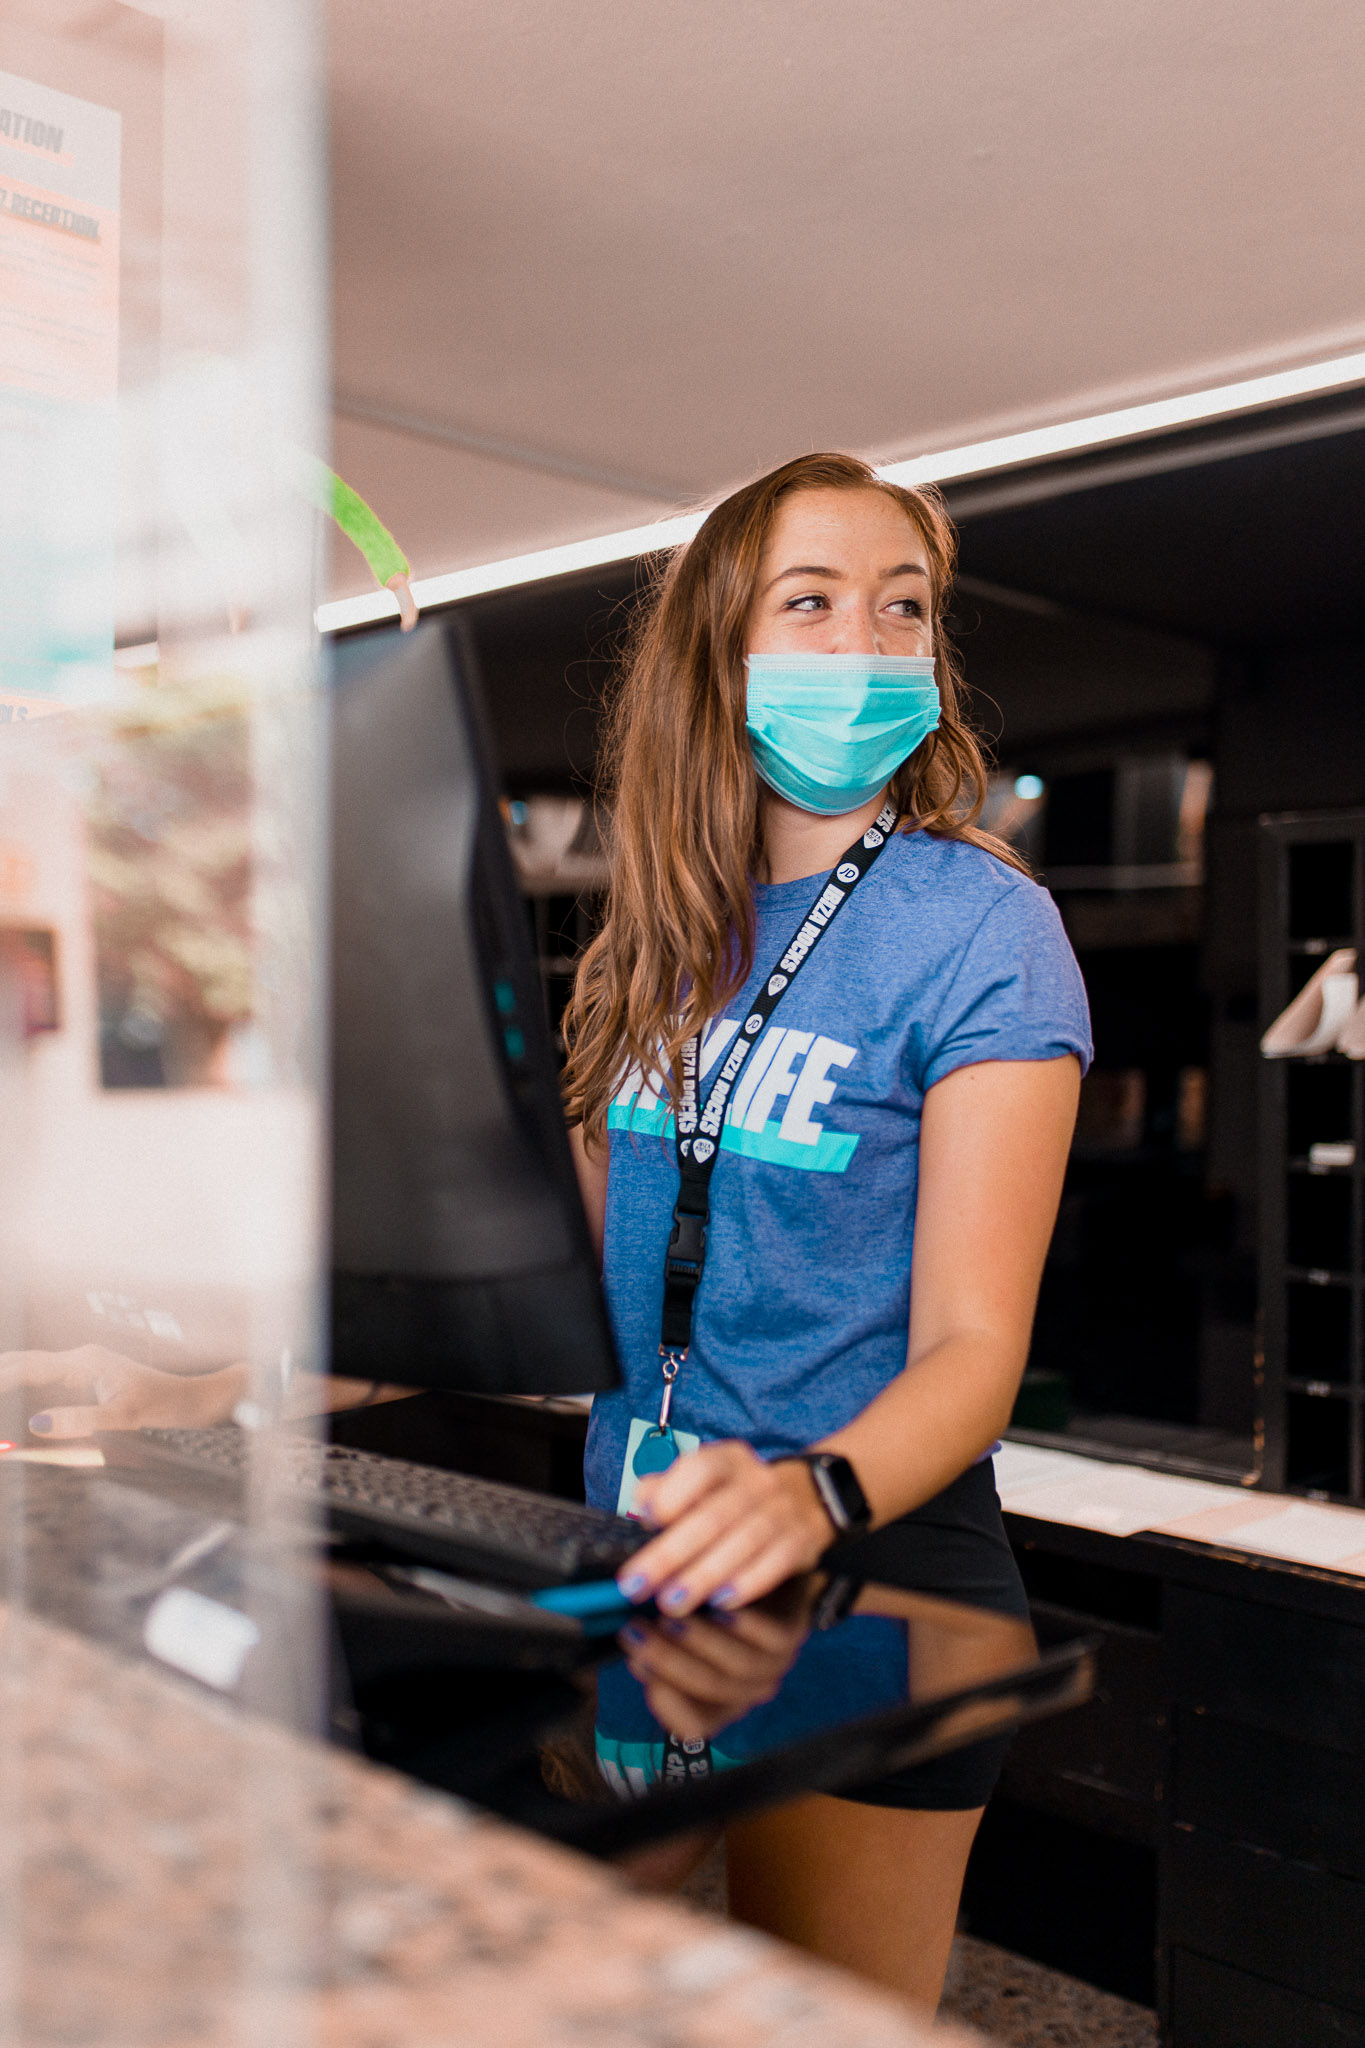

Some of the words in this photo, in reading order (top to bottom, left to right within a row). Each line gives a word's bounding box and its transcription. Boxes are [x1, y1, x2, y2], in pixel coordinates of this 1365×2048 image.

[10, 192, 100, 239] RECEPTION
[808, 883, 846, 927] IBIZA
[780, 921, 821, 973] ROCKS
[720, 1037, 751, 1082] IBIZA
[699, 1078, 731, 1137] ROCKS
